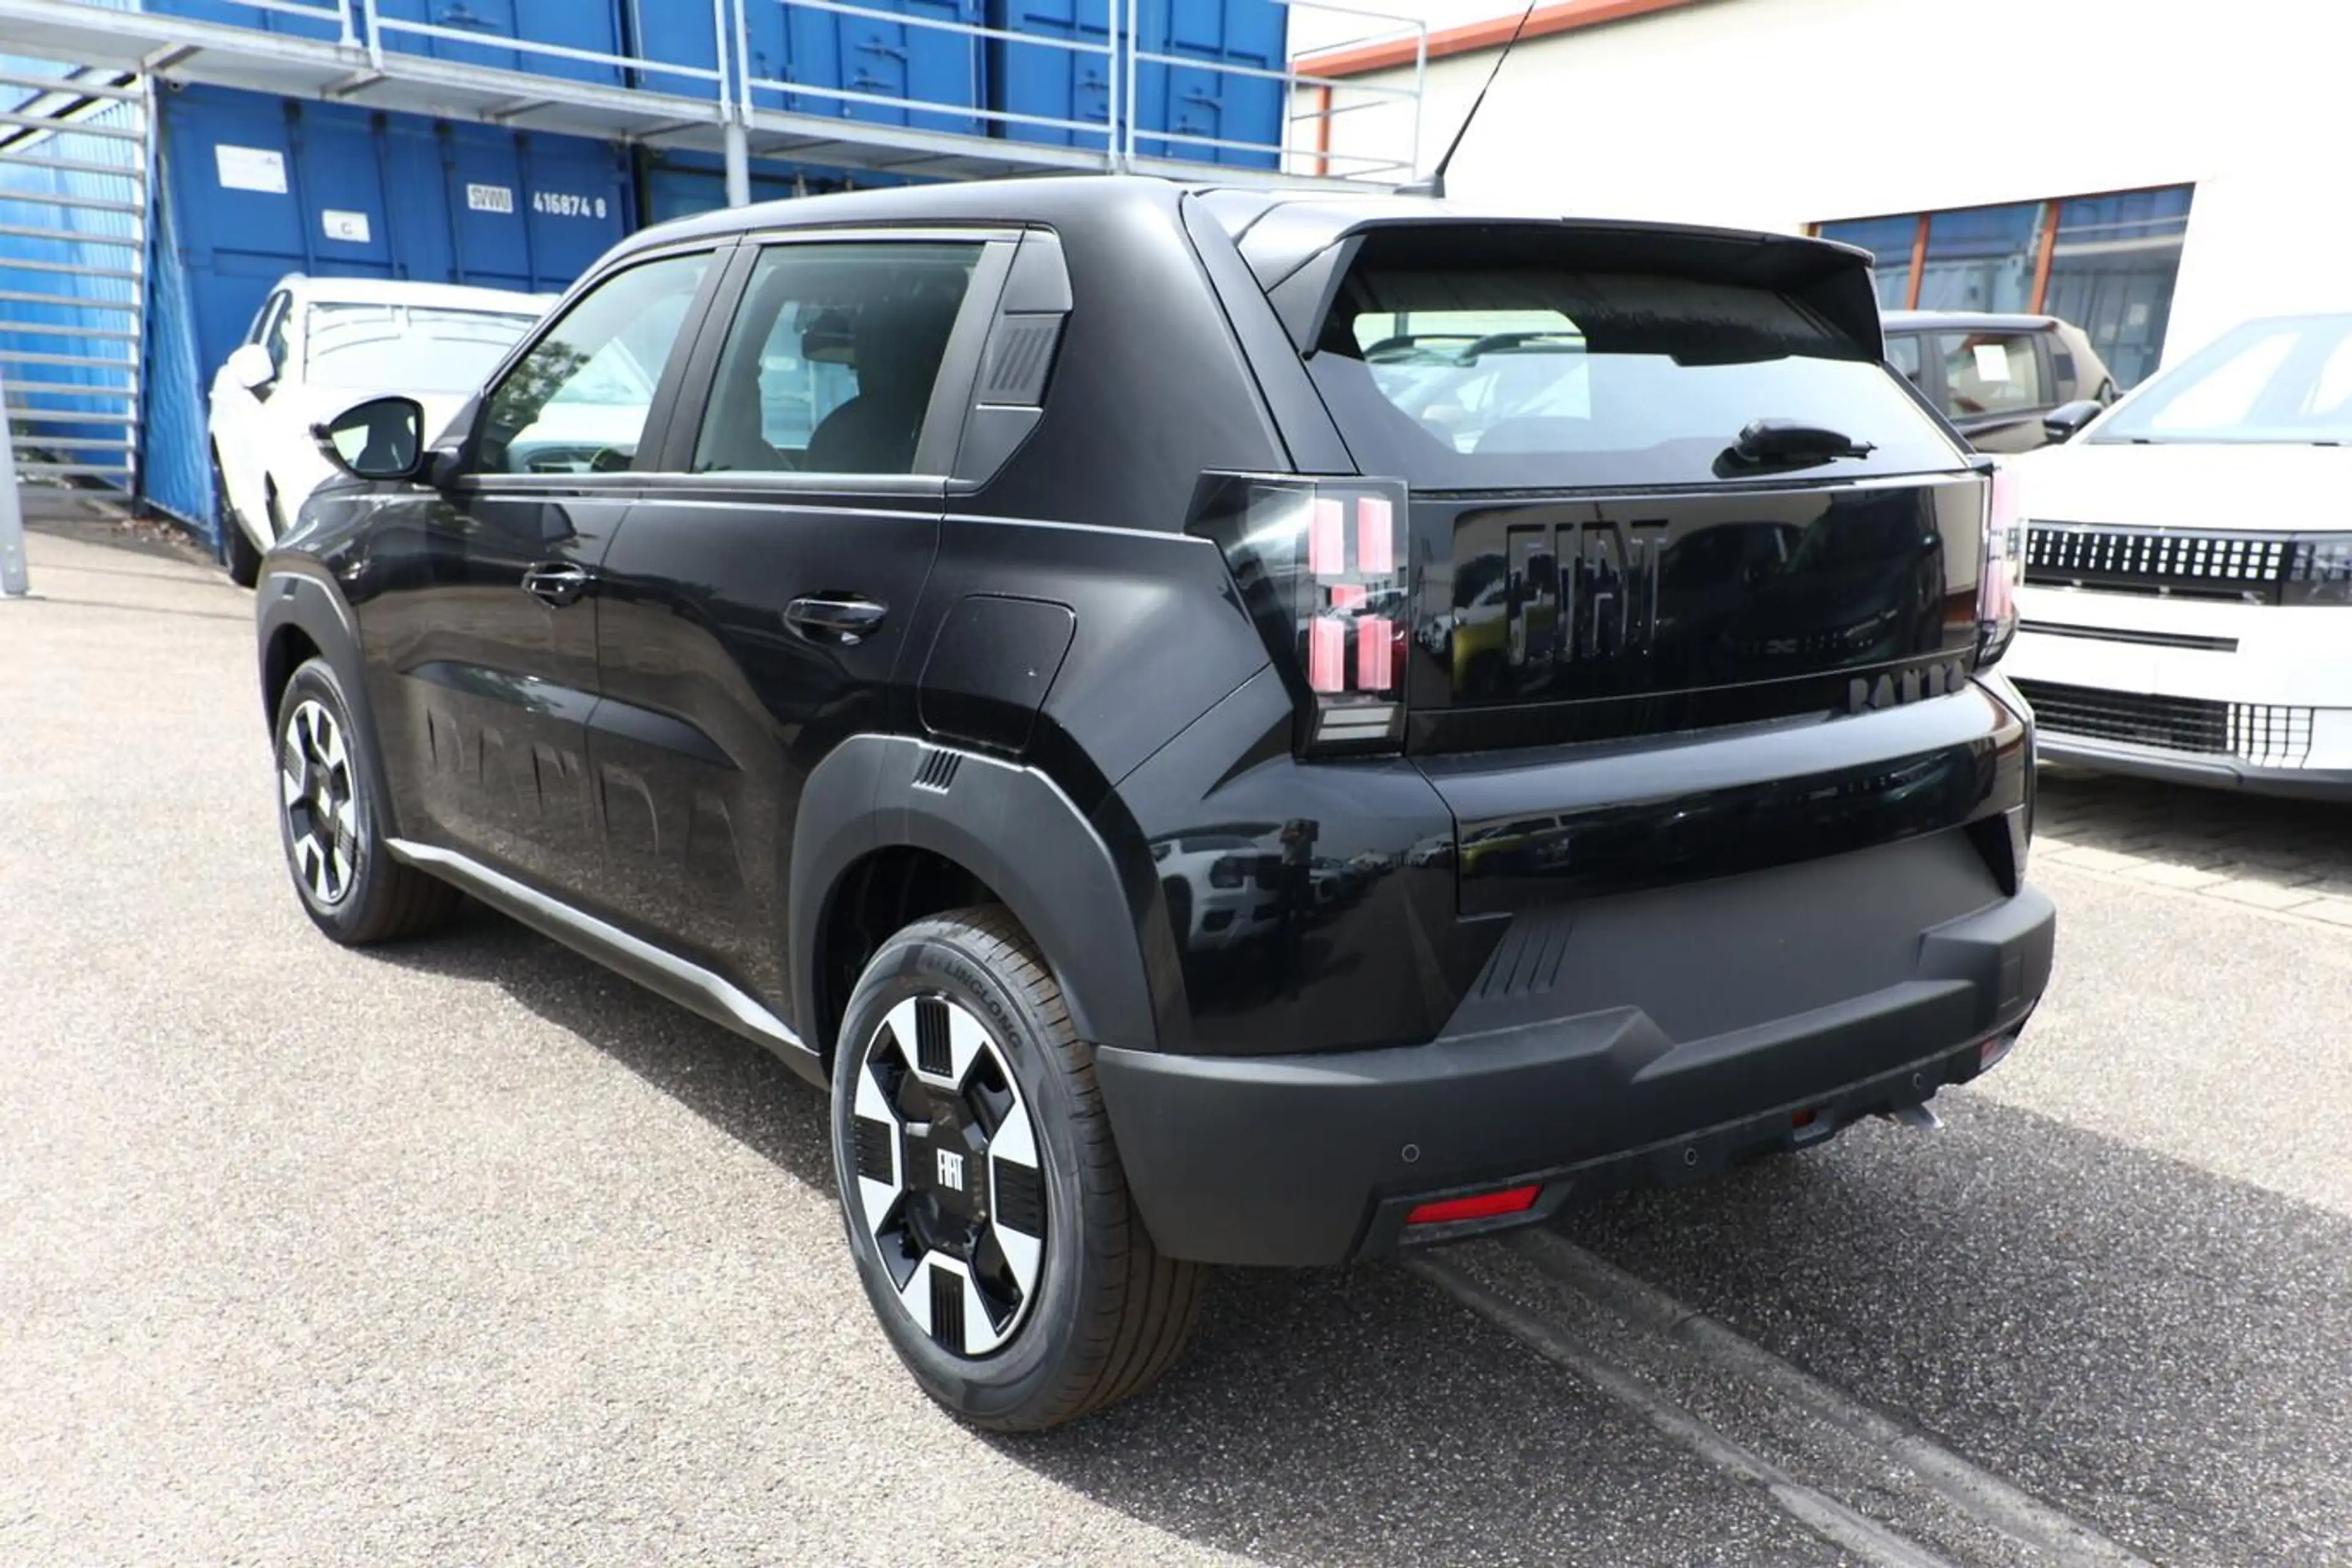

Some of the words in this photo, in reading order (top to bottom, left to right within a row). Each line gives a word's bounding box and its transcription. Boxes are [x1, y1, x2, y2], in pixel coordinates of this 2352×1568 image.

[533, 191, 591, 217] 416874
[595, 197, 606, 219] 8
[1506, 519, 1669, 666] FIAT
[943, 959, 1022, 1049] LINGLONG
[937, 1147, 964, 1192] FIAT
